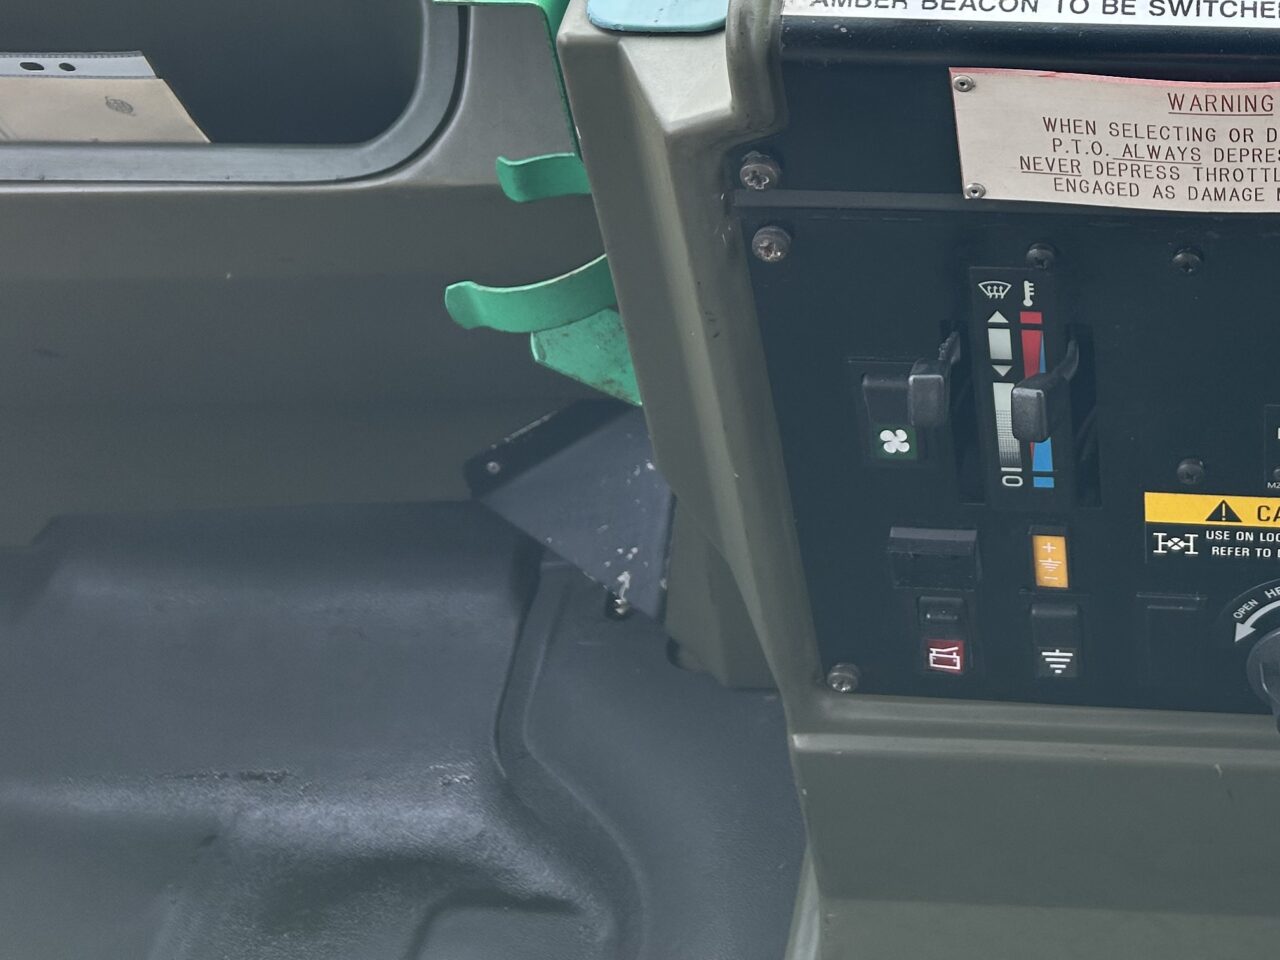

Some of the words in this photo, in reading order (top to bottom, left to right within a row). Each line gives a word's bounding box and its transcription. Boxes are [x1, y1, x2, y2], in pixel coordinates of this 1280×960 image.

[1167, 92, 1275, 113] WARNING
[1042, 116, 1097, 136] WHEN
[1108, 122, 1216, 142] SELECTING
[1229, 127, 1254, 143] OR
[1052, 137, 1110, 157] P.T.O.
[1122, 143, 1202, 162] ALWAYS
[1019, 155, 1081, 174] NEVER
[1093, 160, 1181, 180] DEPRESS
[1054, 177, 1140, 198] ENGAGED
[1152, 184, 1176, 200] AS
[1188, 185, 1265, 202] DAMAGE
[1205, 530, 1230, 541] USE
[1236, 531, 1254, 542] ON
[1211, 546, 1250, 557] REFER
[1255, 547, 1272, 558] TO
[1233, 598, 1259, 620] OPEN
